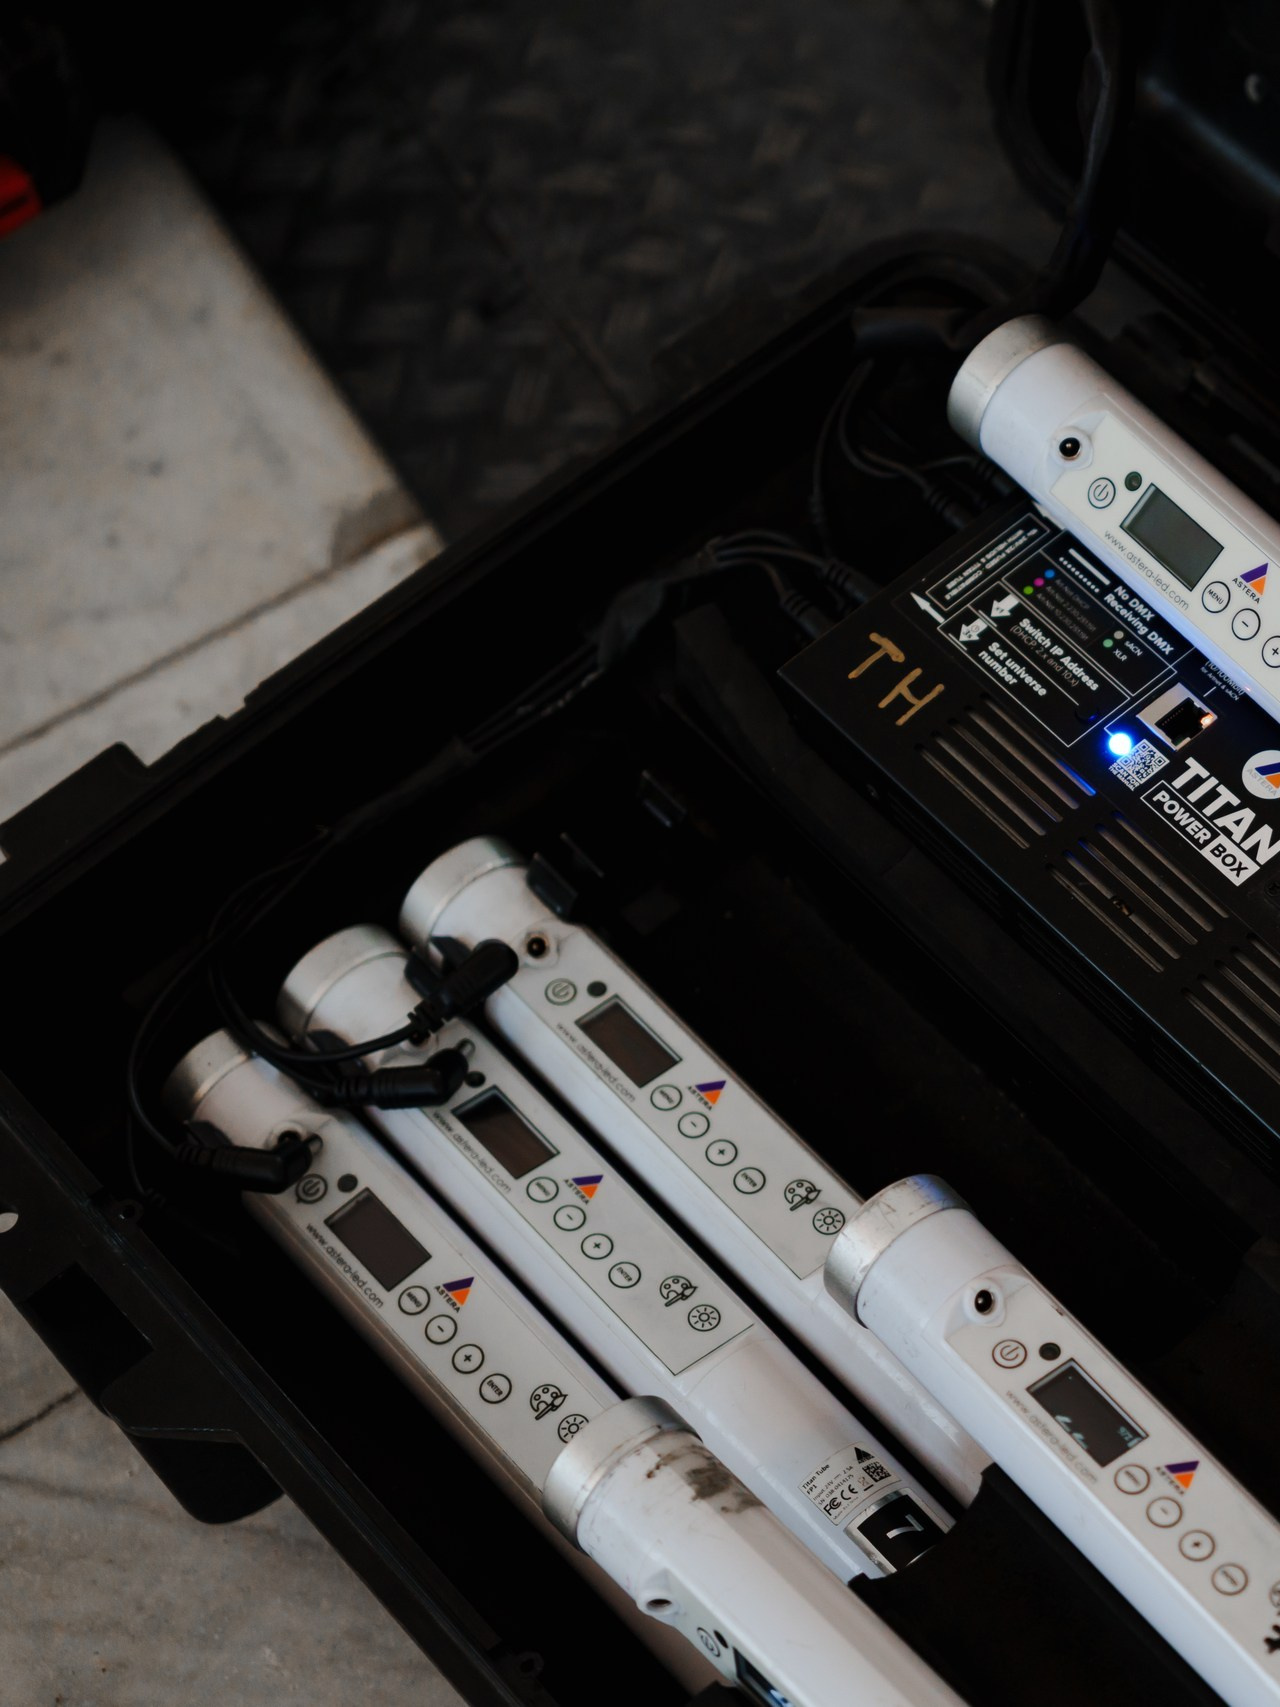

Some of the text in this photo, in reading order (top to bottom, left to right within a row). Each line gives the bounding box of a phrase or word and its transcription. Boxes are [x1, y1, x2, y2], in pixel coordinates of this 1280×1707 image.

[1103, 529, 1191, 612] www.astera-led.com
[1114, 585, 1156, 622] No DMX
[1207, 588, 1225, 606] MENU
[1231, 576, 1262, 605] ASTERA
[1104, 593, 1175, 655] Receiving DMX
[1019, 617, 1099, 691] Switch IP Address
[1113, 648, 1128, 662] XLR
[1124, 640, 1143, 657] sACN
[978, 650, 1018, 685] number
[988, 641, 1047, 697] Set universe
[1046, 657, 1064, 673] and
[1126, 775, 1140, 787] FOR
[1246, 767, 1278, 796] ASTERA
[1152, 790, 1249, 878] POWER BOX
[686, 1084, 716, 1112] ASTERA
[432, 1110, 512, 1195] www.astera-led.com
[564, 1175, 592, 1205] ASTERA
[306, 1222, 385, 1310] www.astera-led.com
[433, 1284, 462, 1314] ASTERA
[486, 1379, 506, 1400] ENTER
[801, 1463, 831, 1490] Titan Tube
[806, 1484, 818, 1495] FP1
[840, 1483, 859, 1500] CE
[885, 1513, 925, 1539] 7
